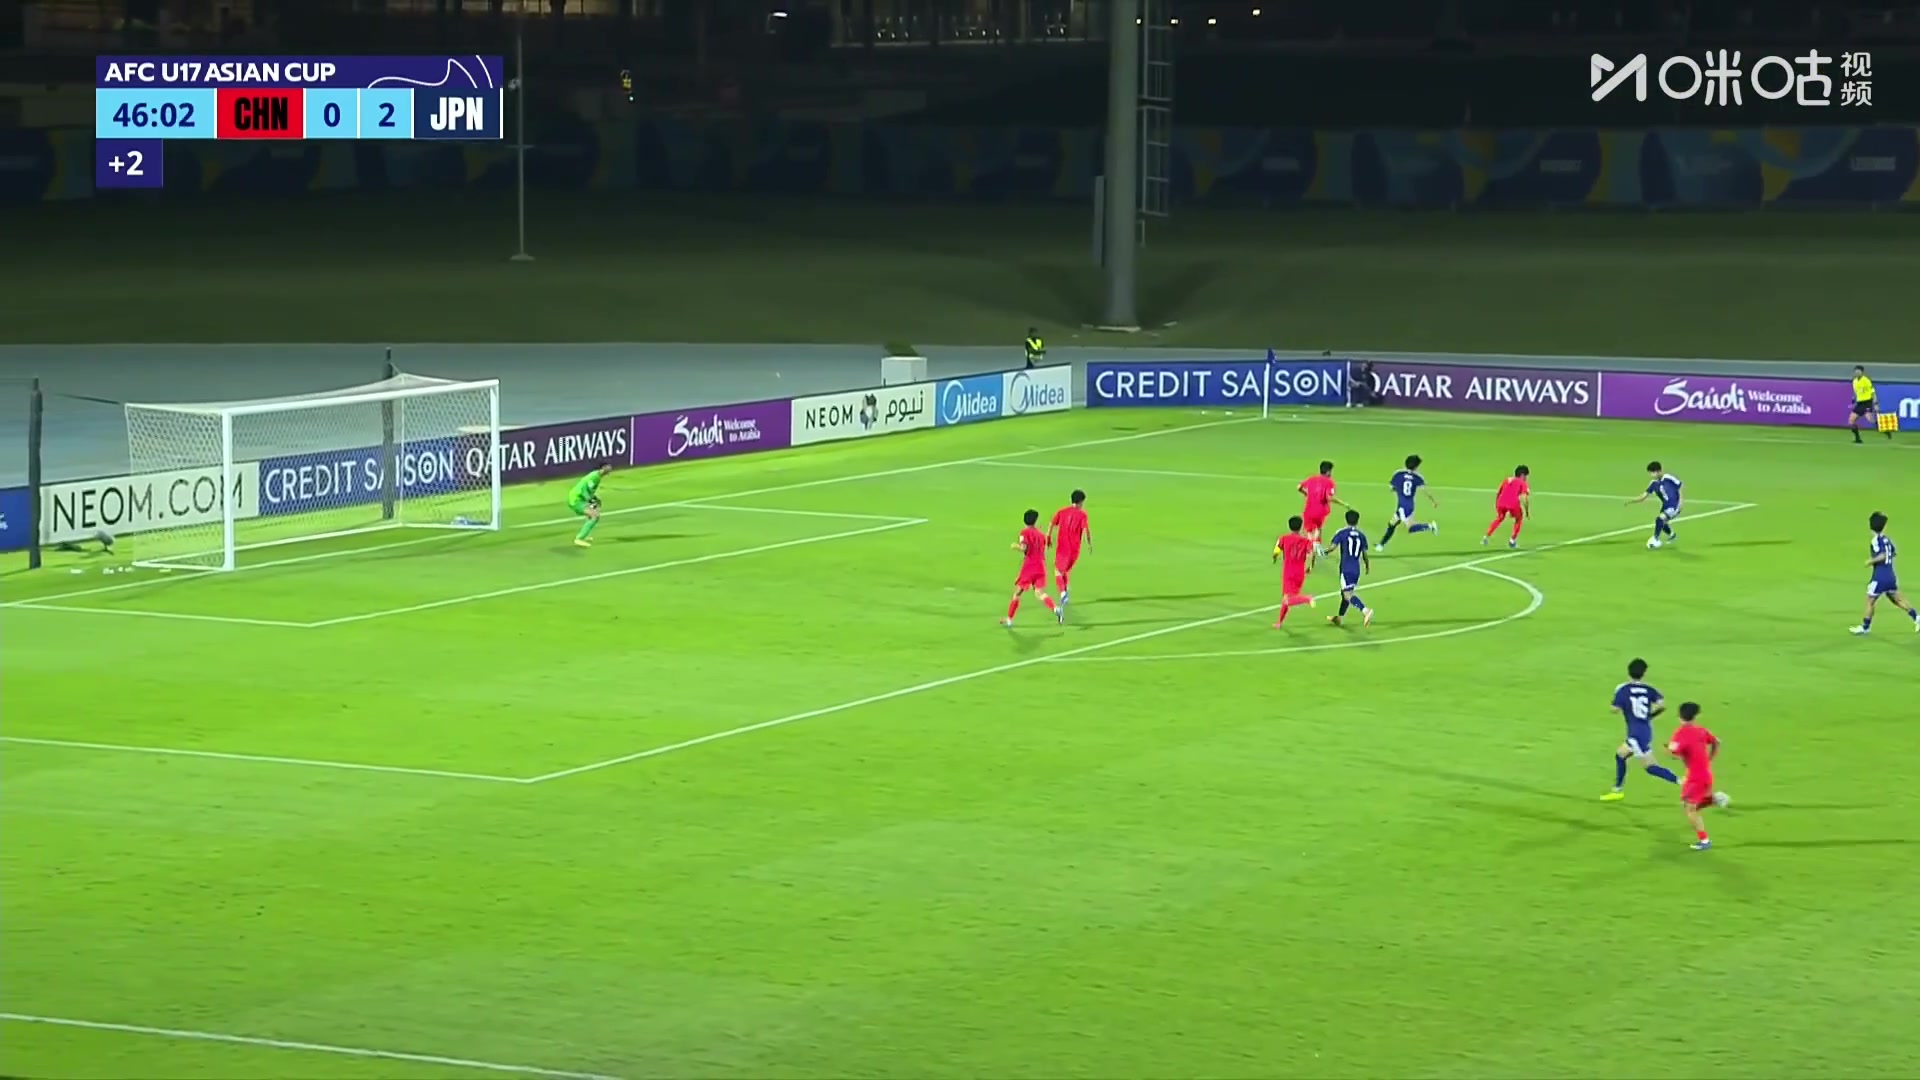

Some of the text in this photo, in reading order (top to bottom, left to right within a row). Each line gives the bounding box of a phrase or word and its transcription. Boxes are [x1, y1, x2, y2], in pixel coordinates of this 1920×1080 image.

[1012, 378, 1064, 412] Midea
[1095, 369, 1342, 398] CREDIT SASON
[1465, 376, 1589, 405] AIRWAYS
[1654, 378, 1748, 415] Saudi
[1747, 389, 1803, 403] Welcome
[805, 404, 853, 429] NEOM
[885, 390, 923, 425] نيوم
[945, 385, 997, 422] Midea
[1757, 402, 1812, 415] to Arabia
[544, 427, 626, 466] AIRWAYS
[667, 414, 723, 456] Saudi
[265, 460, 356, 503] CREDIT
[1403, 480, 1413, 496] 8
[53, 471, 242, 533] NEOM.COM
[1348, 536, 1361, 557] 11
[1630, 696, 1649, 719] 16
